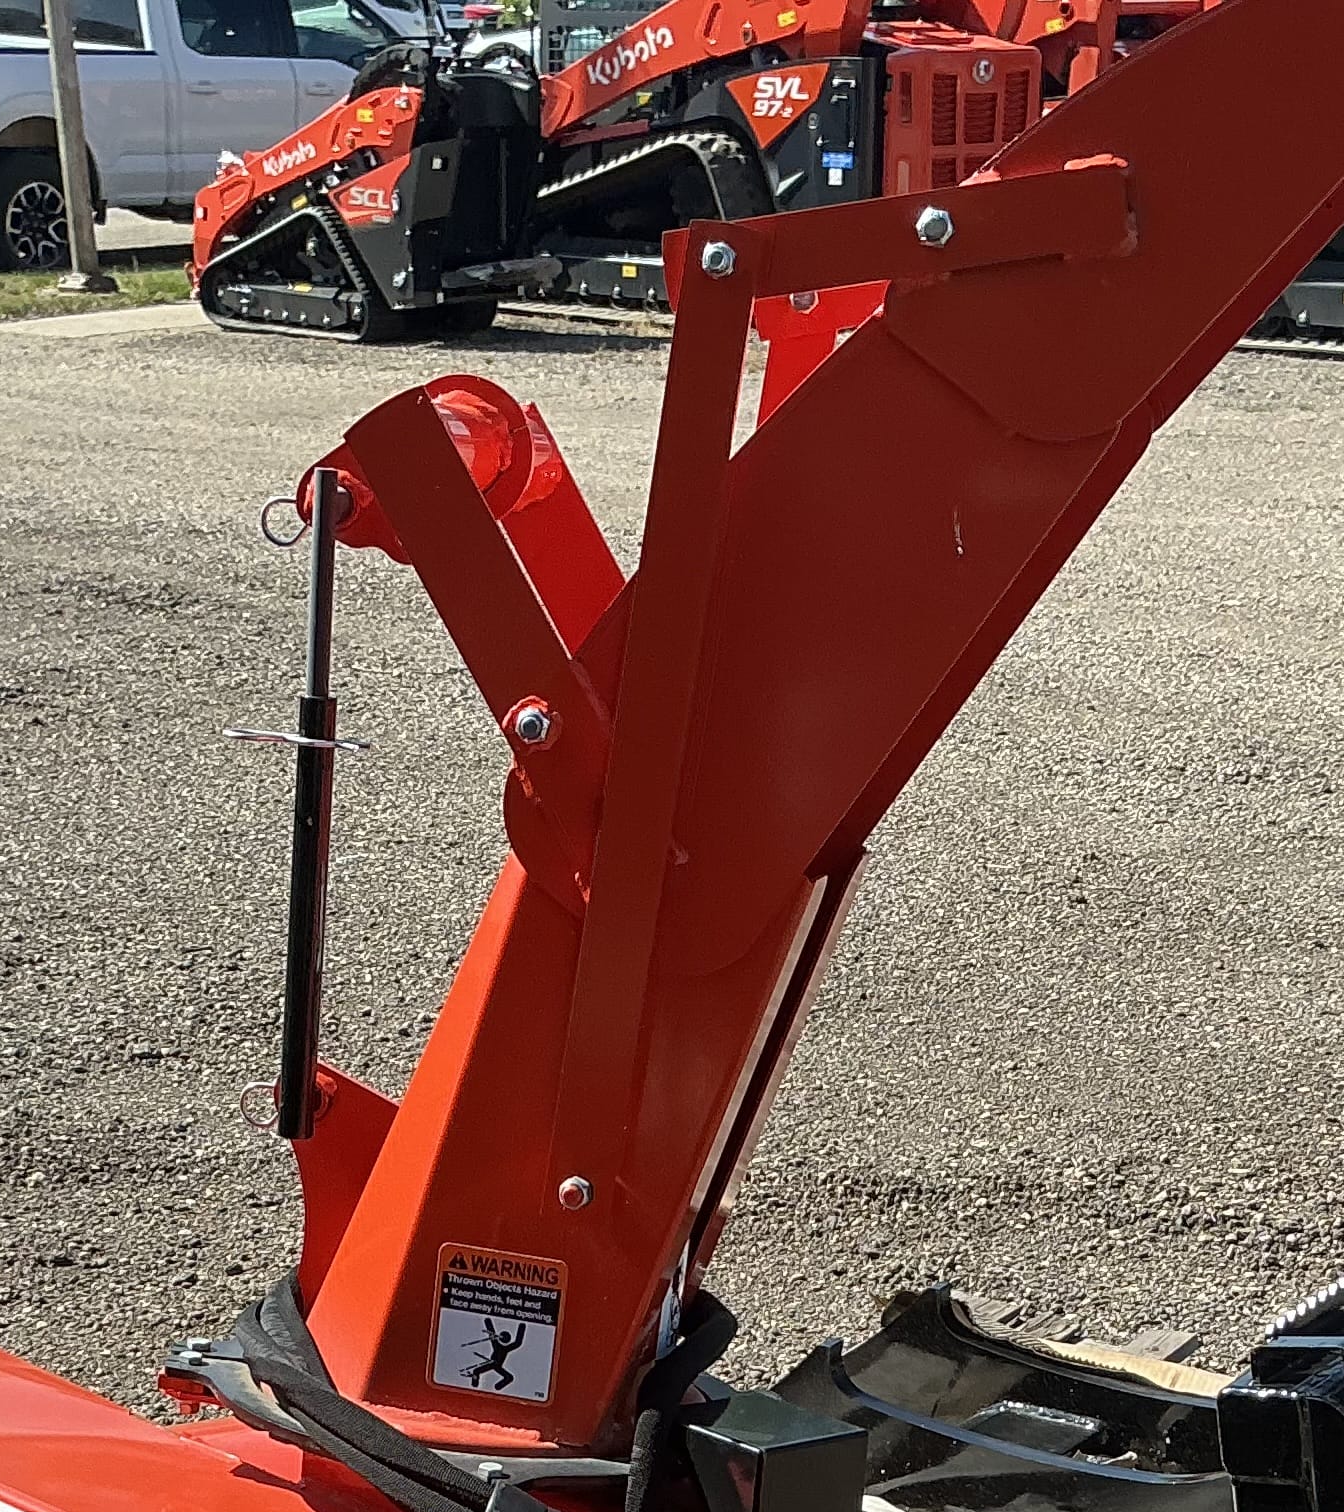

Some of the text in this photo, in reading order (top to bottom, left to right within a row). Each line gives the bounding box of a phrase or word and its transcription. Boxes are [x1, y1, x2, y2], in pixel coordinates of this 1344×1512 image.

[586, 25, 674, 85] Kubota
[753, 76, 809, 99] SVL
[752, 100, 794, 118] 97-2
[262, 138, 317, 177] Kubota
[349, 186, 390, 210] SCL
[471, 1254, 559, 1285] WARNING
[447, 1272, 558, 1300] Thrown Objects Hazard
[451, 1287, 474, 1299] Keep
[524, 1299, 542, 1309] and
